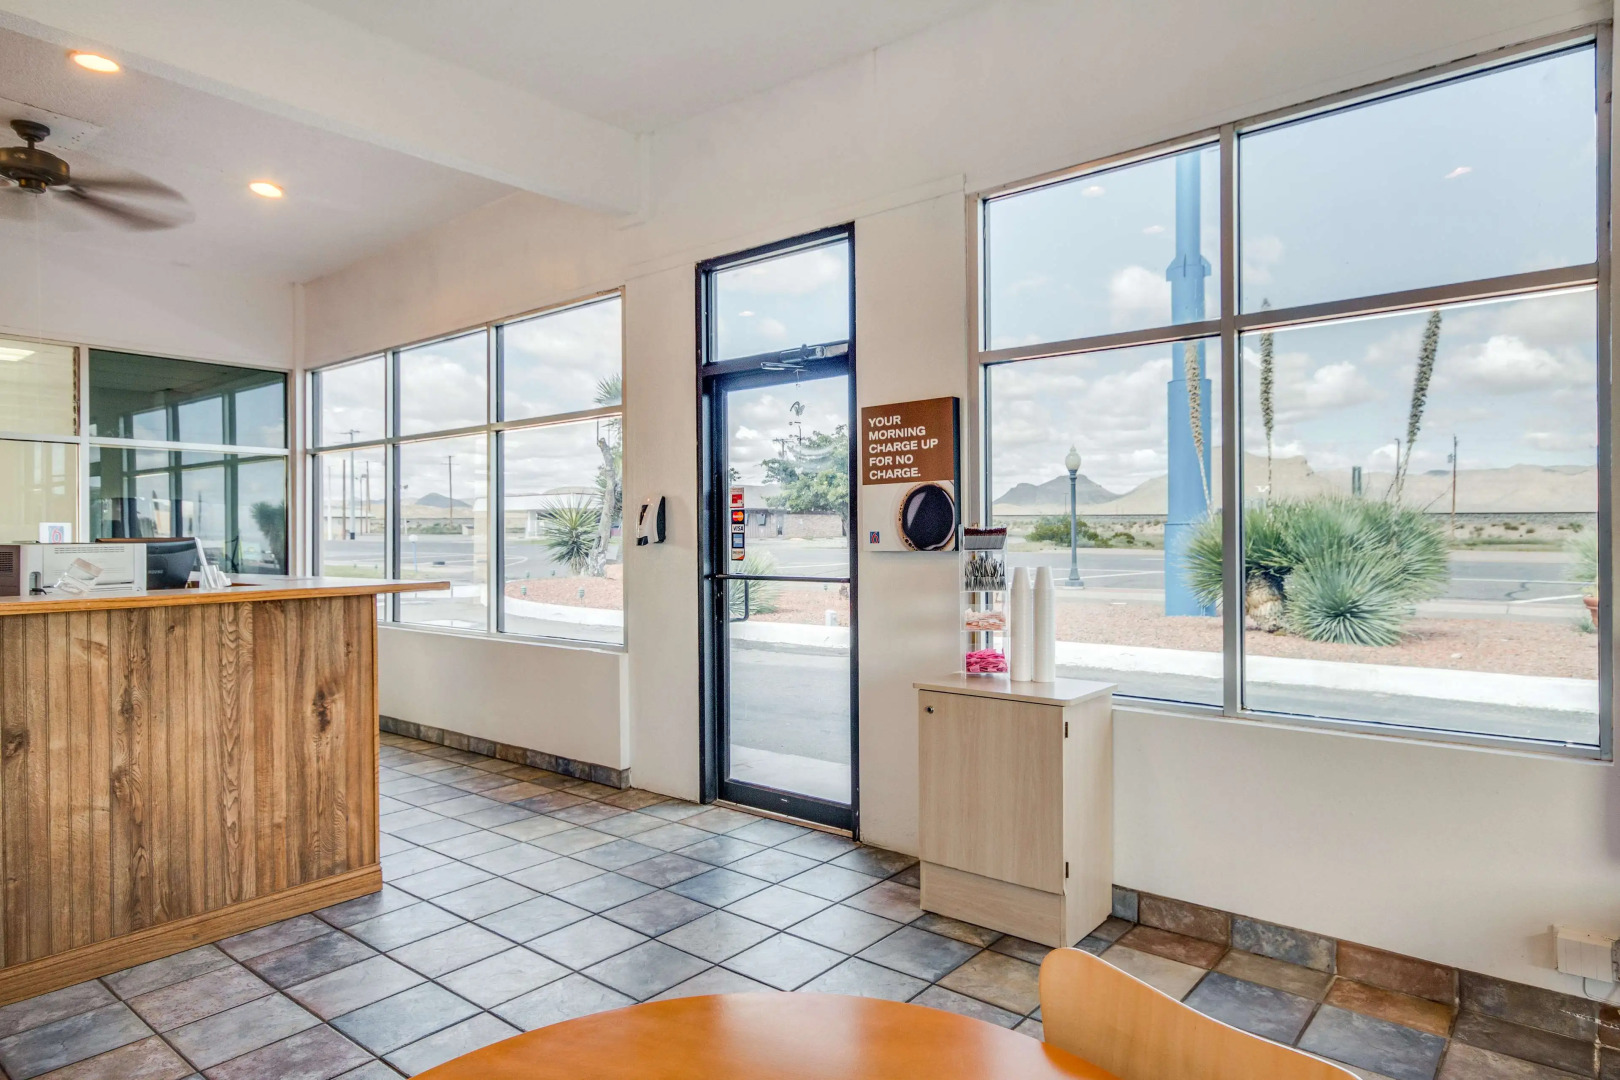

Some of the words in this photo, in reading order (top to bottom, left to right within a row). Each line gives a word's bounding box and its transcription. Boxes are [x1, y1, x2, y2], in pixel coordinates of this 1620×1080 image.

[868, 415, 901, 428] YOUR
[868, 426, 926, 441] MORNING
[868, 440, 918, 454] CHARGE
[921, 438, 939, 449] UP
[869, 456, 893, 467] FOR
[895, 454, 914, 465] NO
[869, 467, 921, 480] CHARGE.
